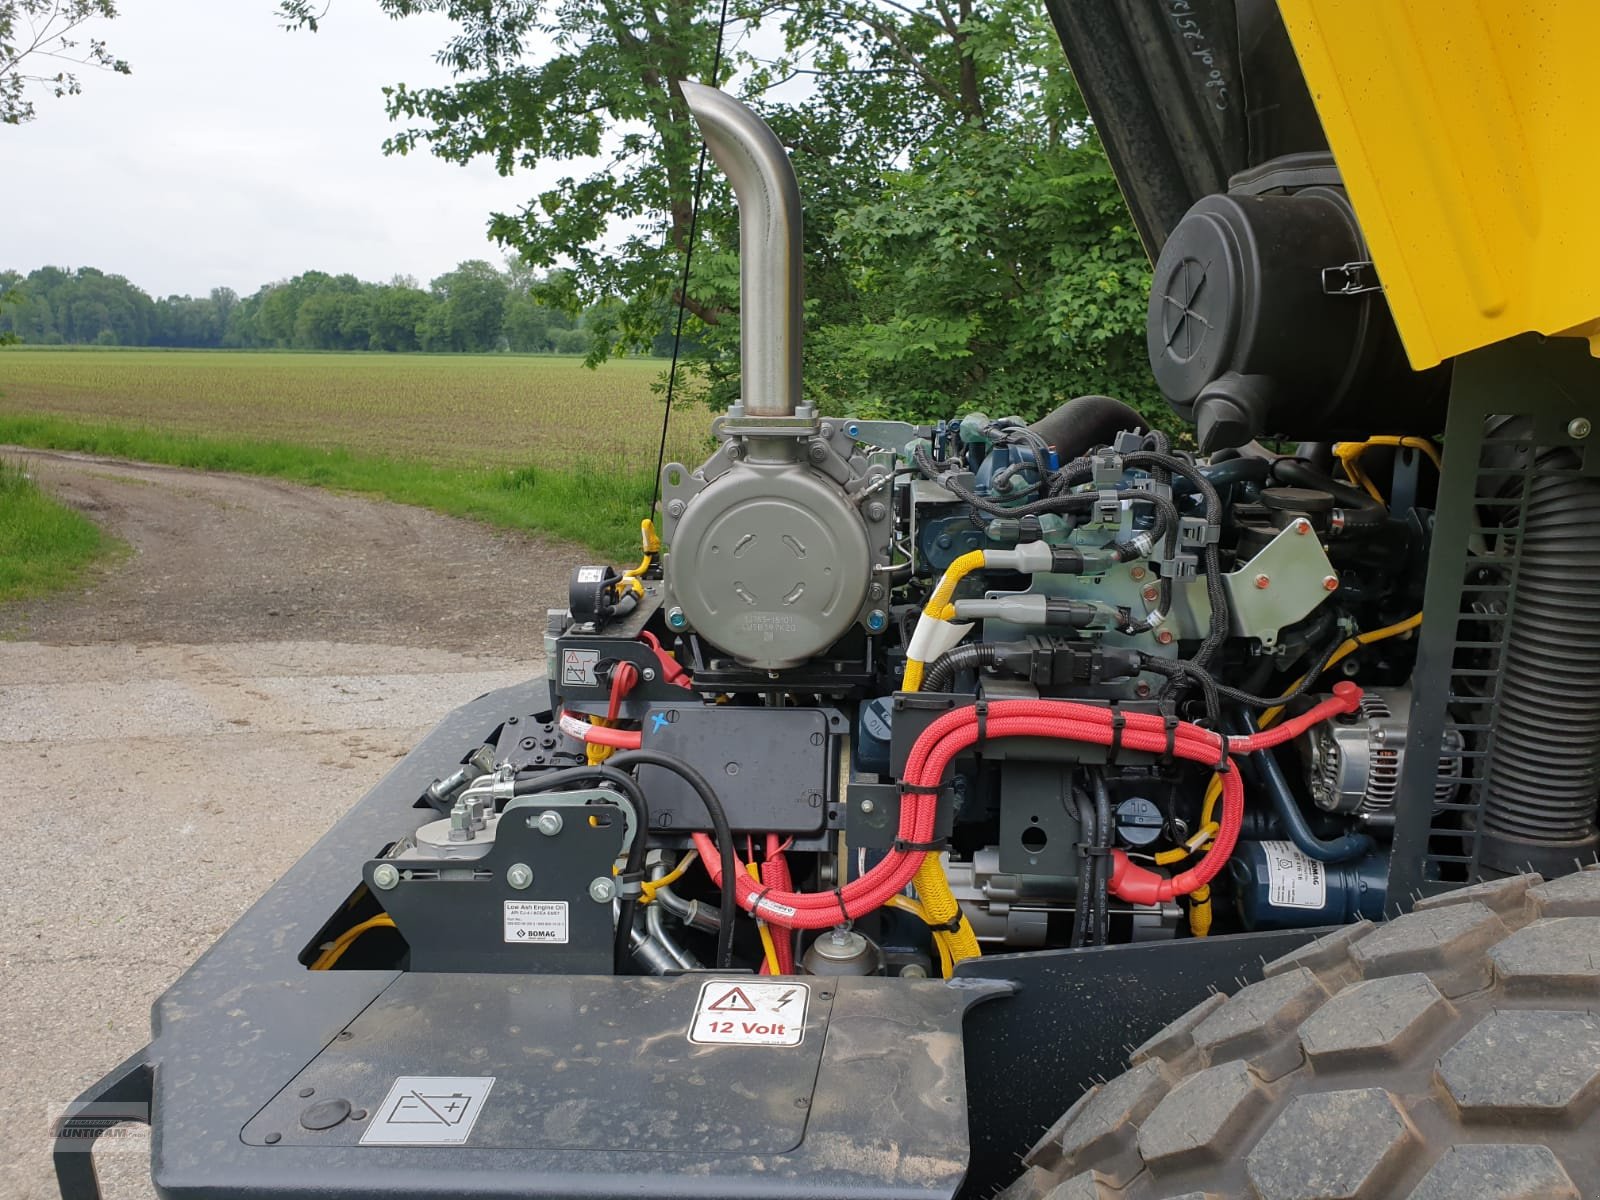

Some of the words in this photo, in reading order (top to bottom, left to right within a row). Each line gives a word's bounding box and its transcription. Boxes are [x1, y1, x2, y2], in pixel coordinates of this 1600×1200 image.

[870, 719, 882, 736] OIL
[1131, 802, 1147, 813] OIL
[709, 1021, 734, 1034] 12
[742, 1022, 786, 1035] Volt
